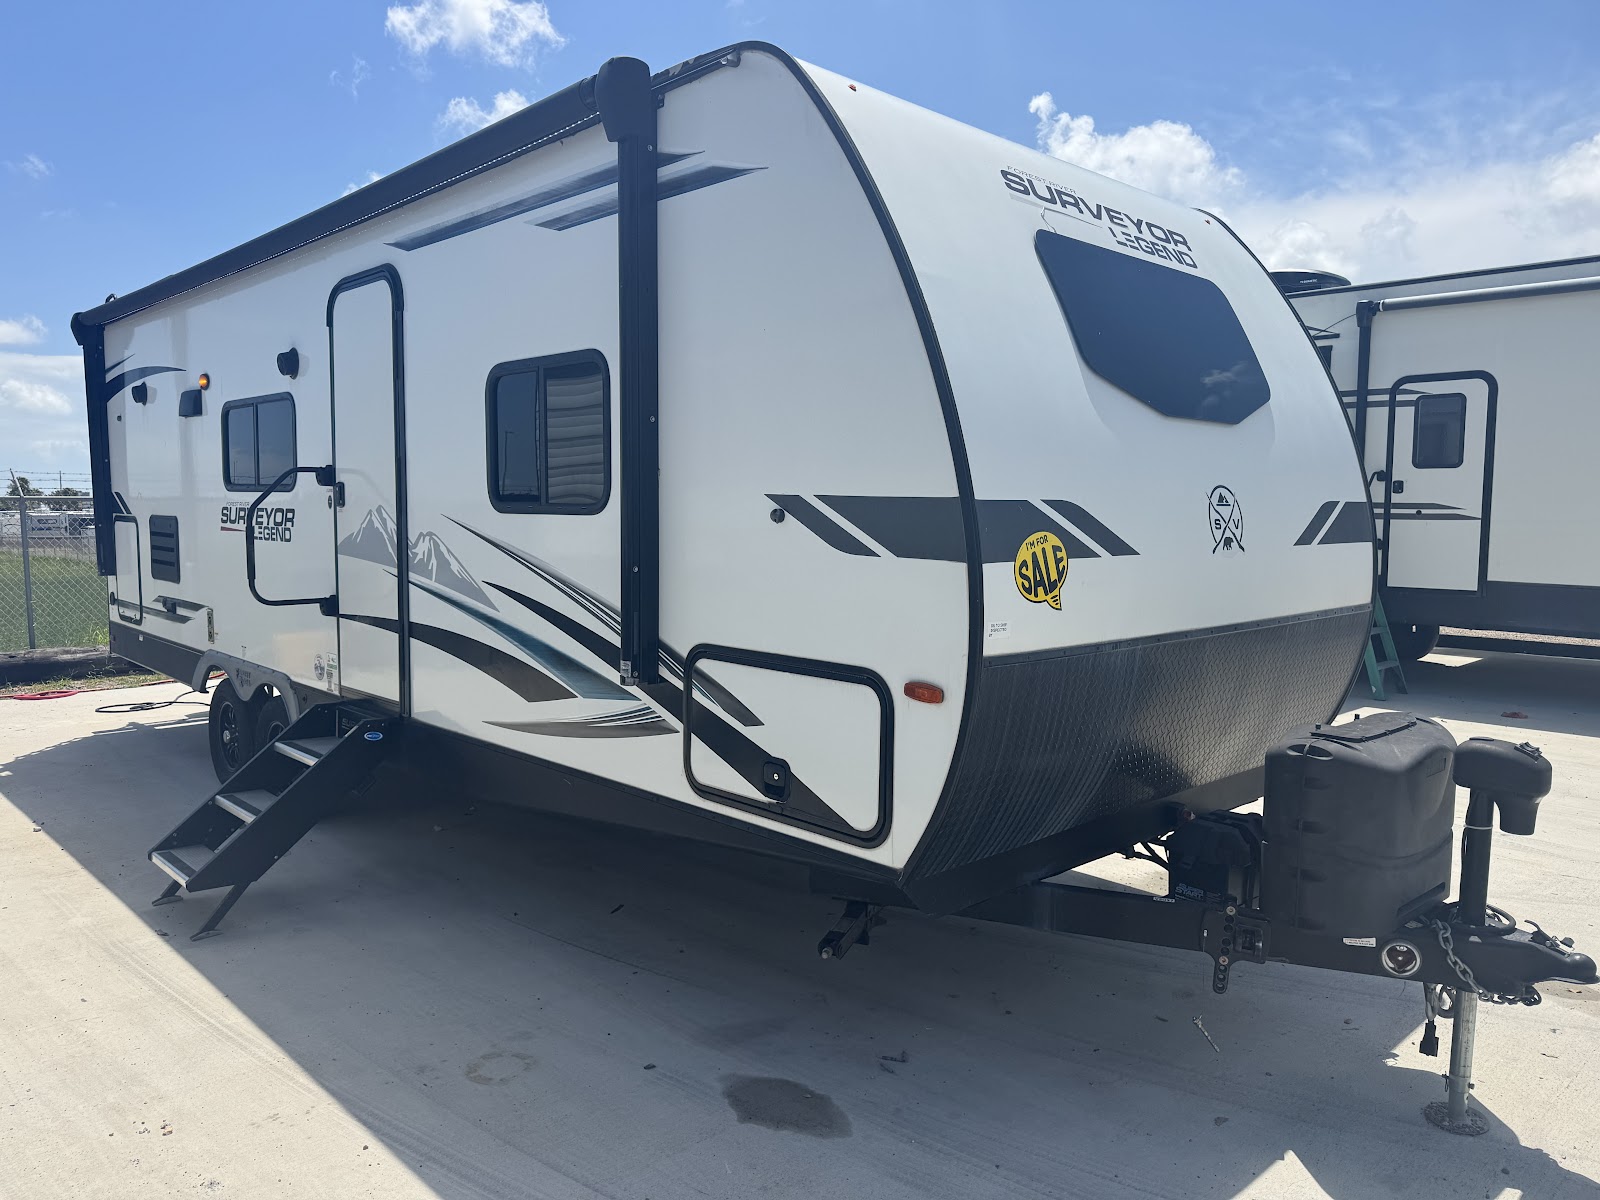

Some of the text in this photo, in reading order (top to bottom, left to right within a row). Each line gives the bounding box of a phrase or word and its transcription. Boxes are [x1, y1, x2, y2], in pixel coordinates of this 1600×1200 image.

[1000, 169, 1193, 252] SURVEYOR
[1107, 226, 1198, 269] LEGEND
[221, 507, 295, 528] SUREYOR
[1214, 518, 1240, 530] S V
[1025, 534, 1049, 551] I'M FOR
[1018, 545, 1066, 599] SALE
